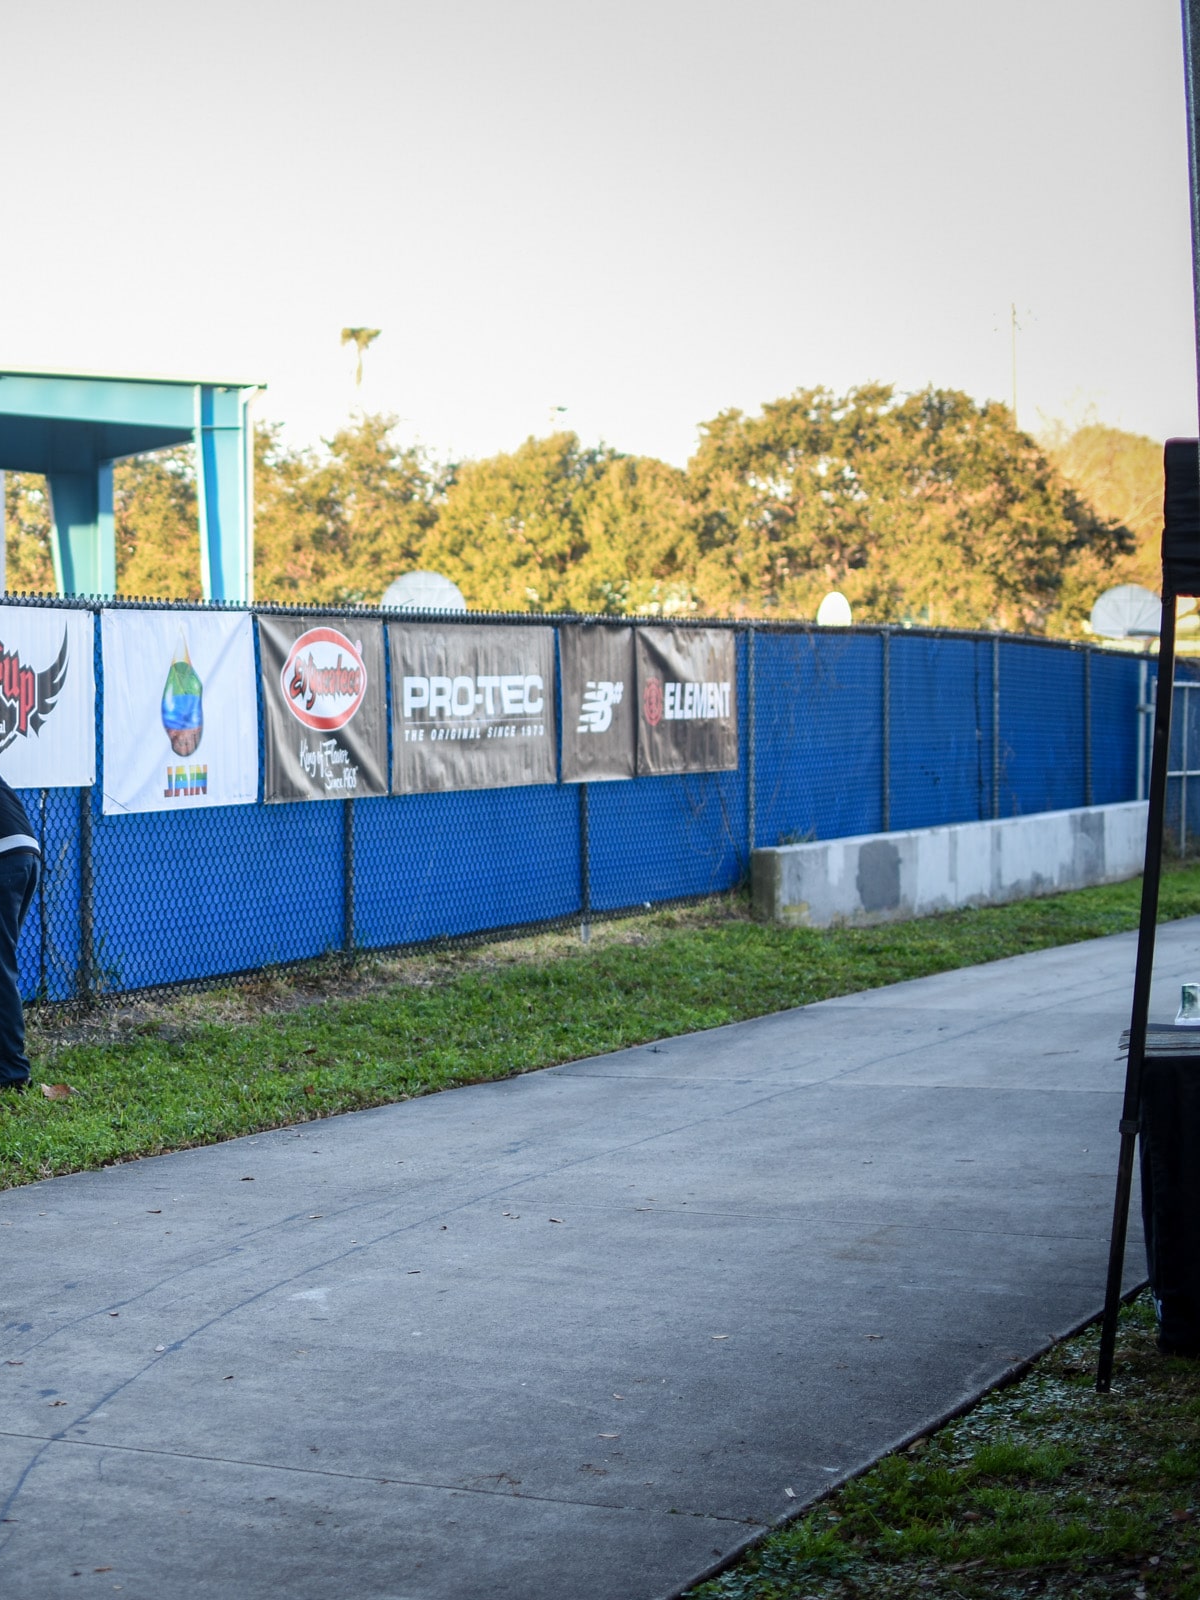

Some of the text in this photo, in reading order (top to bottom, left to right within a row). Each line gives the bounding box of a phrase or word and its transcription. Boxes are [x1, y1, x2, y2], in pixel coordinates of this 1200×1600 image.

[665, 682, 731, 720] ELEMENT
[404, 725, 544, 742] THE ORIGINAL SINCE 1973
[164, 764, 208, 798] JAIN
